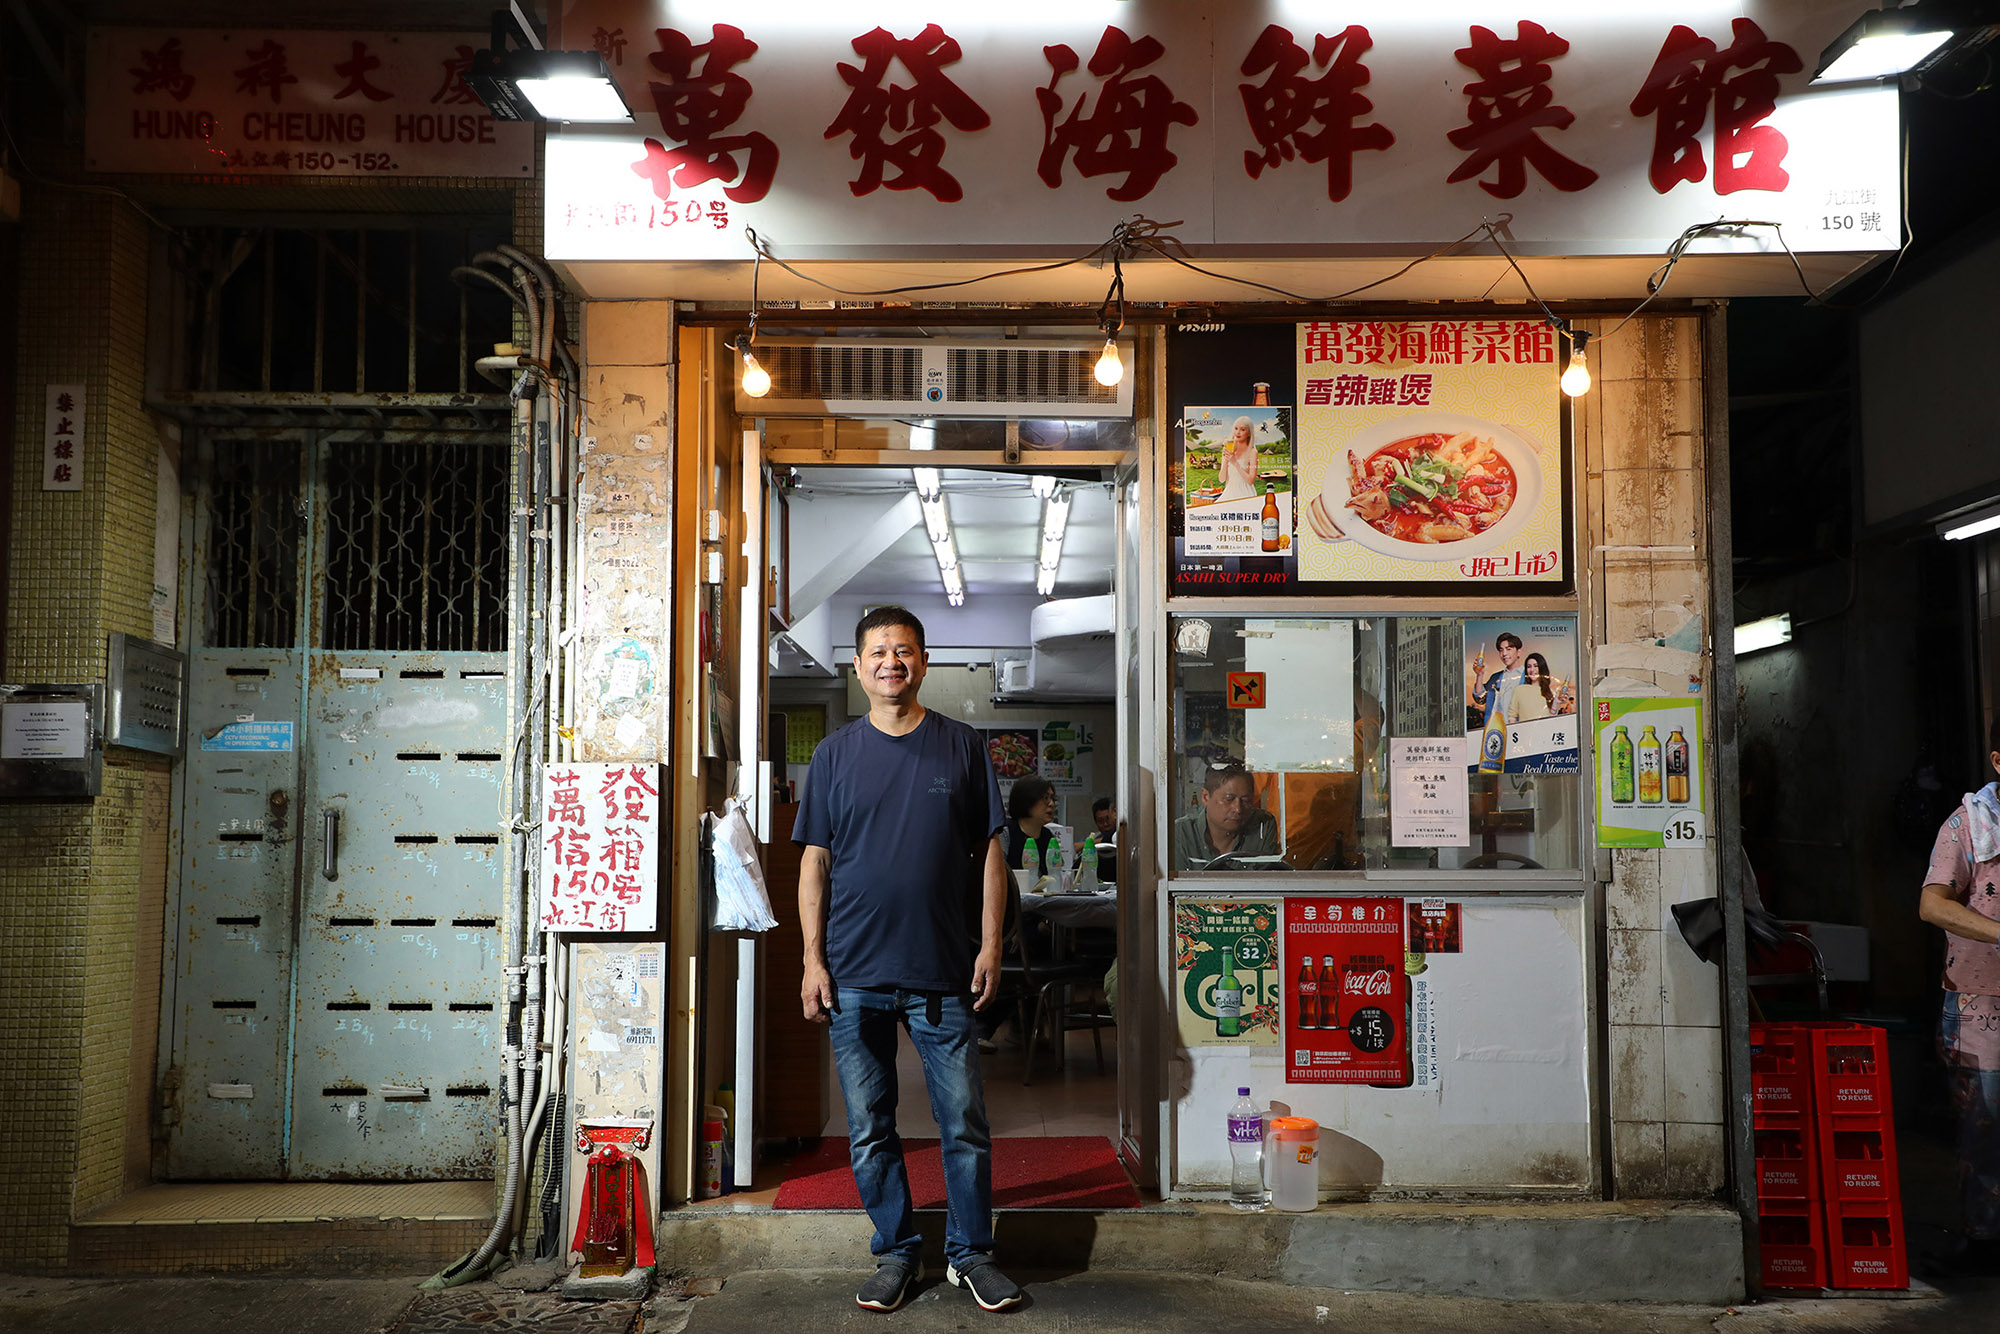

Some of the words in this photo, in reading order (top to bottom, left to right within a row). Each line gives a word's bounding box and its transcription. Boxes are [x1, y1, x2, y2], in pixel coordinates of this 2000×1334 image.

[631, 18, 1803, 203] 萬發海鮮菜館
[134, 110, 214, 140] HUNG
[243, 113, 365, 143] CHEUNG
[395, 116, 496, 143] HOUSE
[1822, 215, 1854, 230] 150
[1303, 321, 1554, 364] 萬發海鮮菜館
[1304, 373, 1432, 406] 香辣雞煲
[1460, 551, 1557, 577] 現已上市
[1175, 572, 1215, 583] ASAHI
[1217, 572, 1260, 583] SUPER
[1263, 572, 1290, 583] DRY
[1512, 732, 1518, 743] $
[1544, 754, 1567, 763] Taste
[1523, 764, 1543, 774] Real
[1544, 764, 1578, 774] Moment
[547, 764, 658, 826] 萬發
[547, 825, 645, 872] 信箱
[1242, 948, 1260, 960] 32
[626, 1036, 656, 1044] 69111711
[1234, 1122, 1261, 1137] vita
